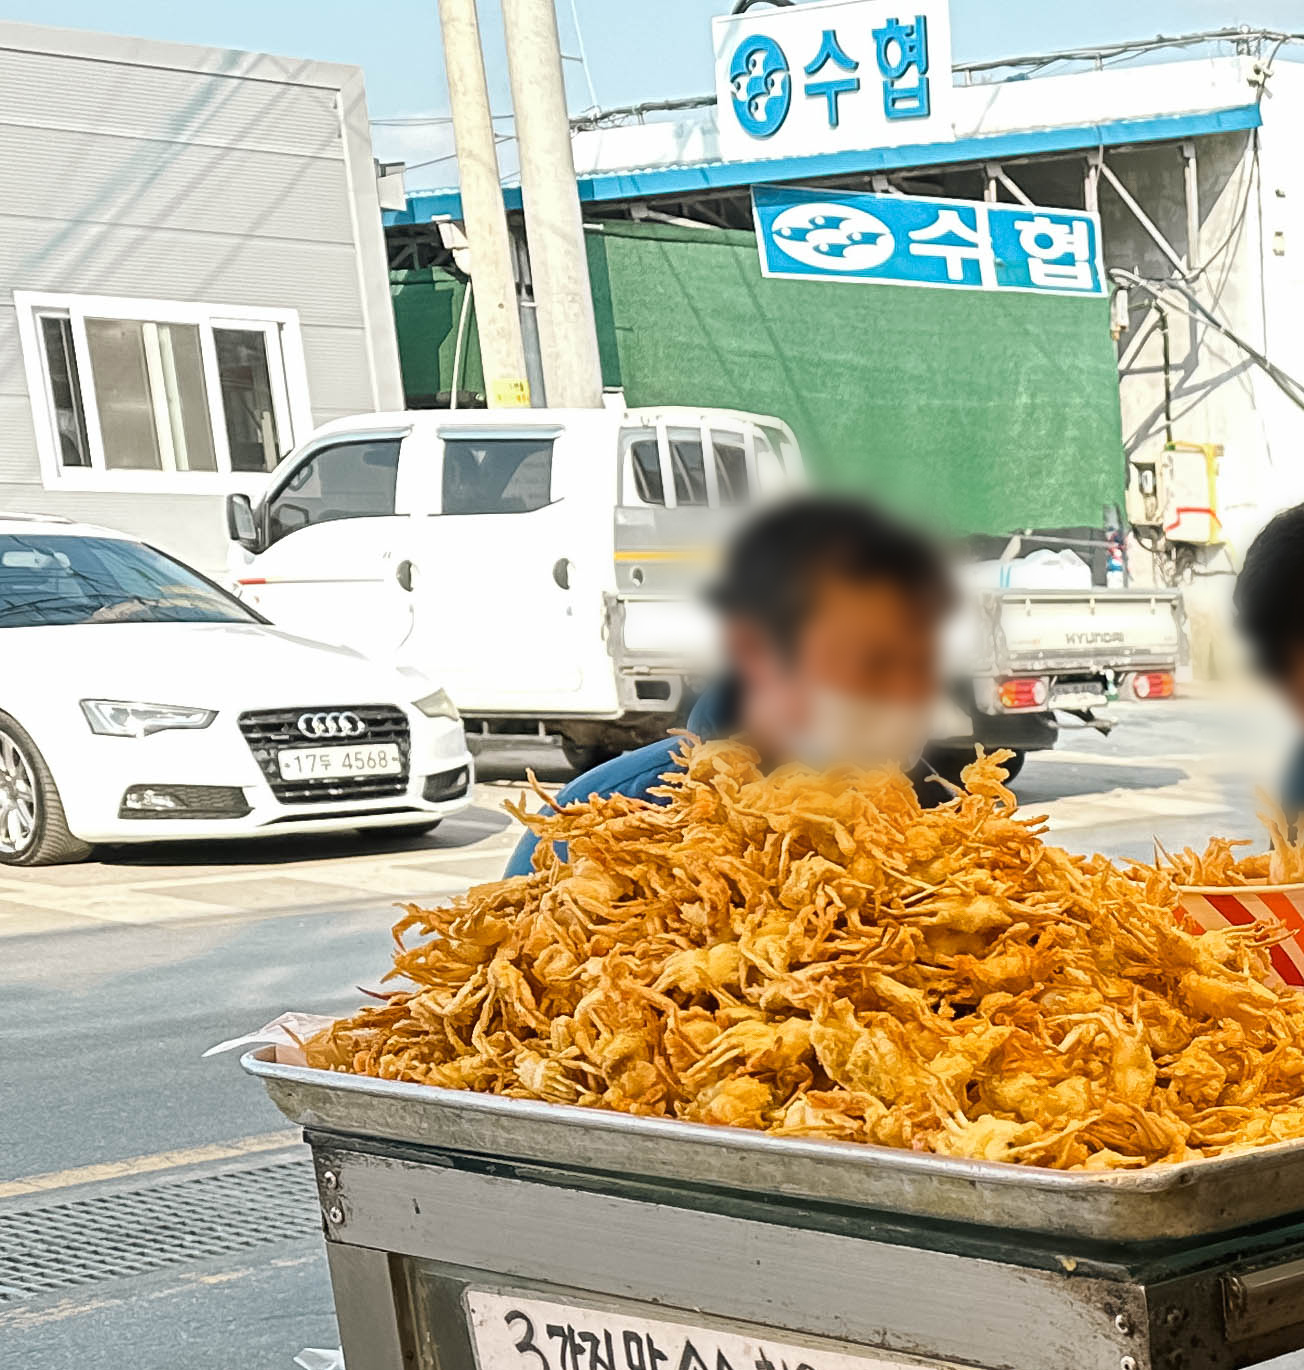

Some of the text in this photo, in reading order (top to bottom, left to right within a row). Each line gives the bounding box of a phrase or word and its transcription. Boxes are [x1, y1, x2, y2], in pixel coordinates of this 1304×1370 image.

[803, 14, 931, 128] 수협
[908, 208, 1096, 289] 수협
[1065, 631, 1126, 645] HYUNDAI
[293, 749, 389, 773] 17두 4568
